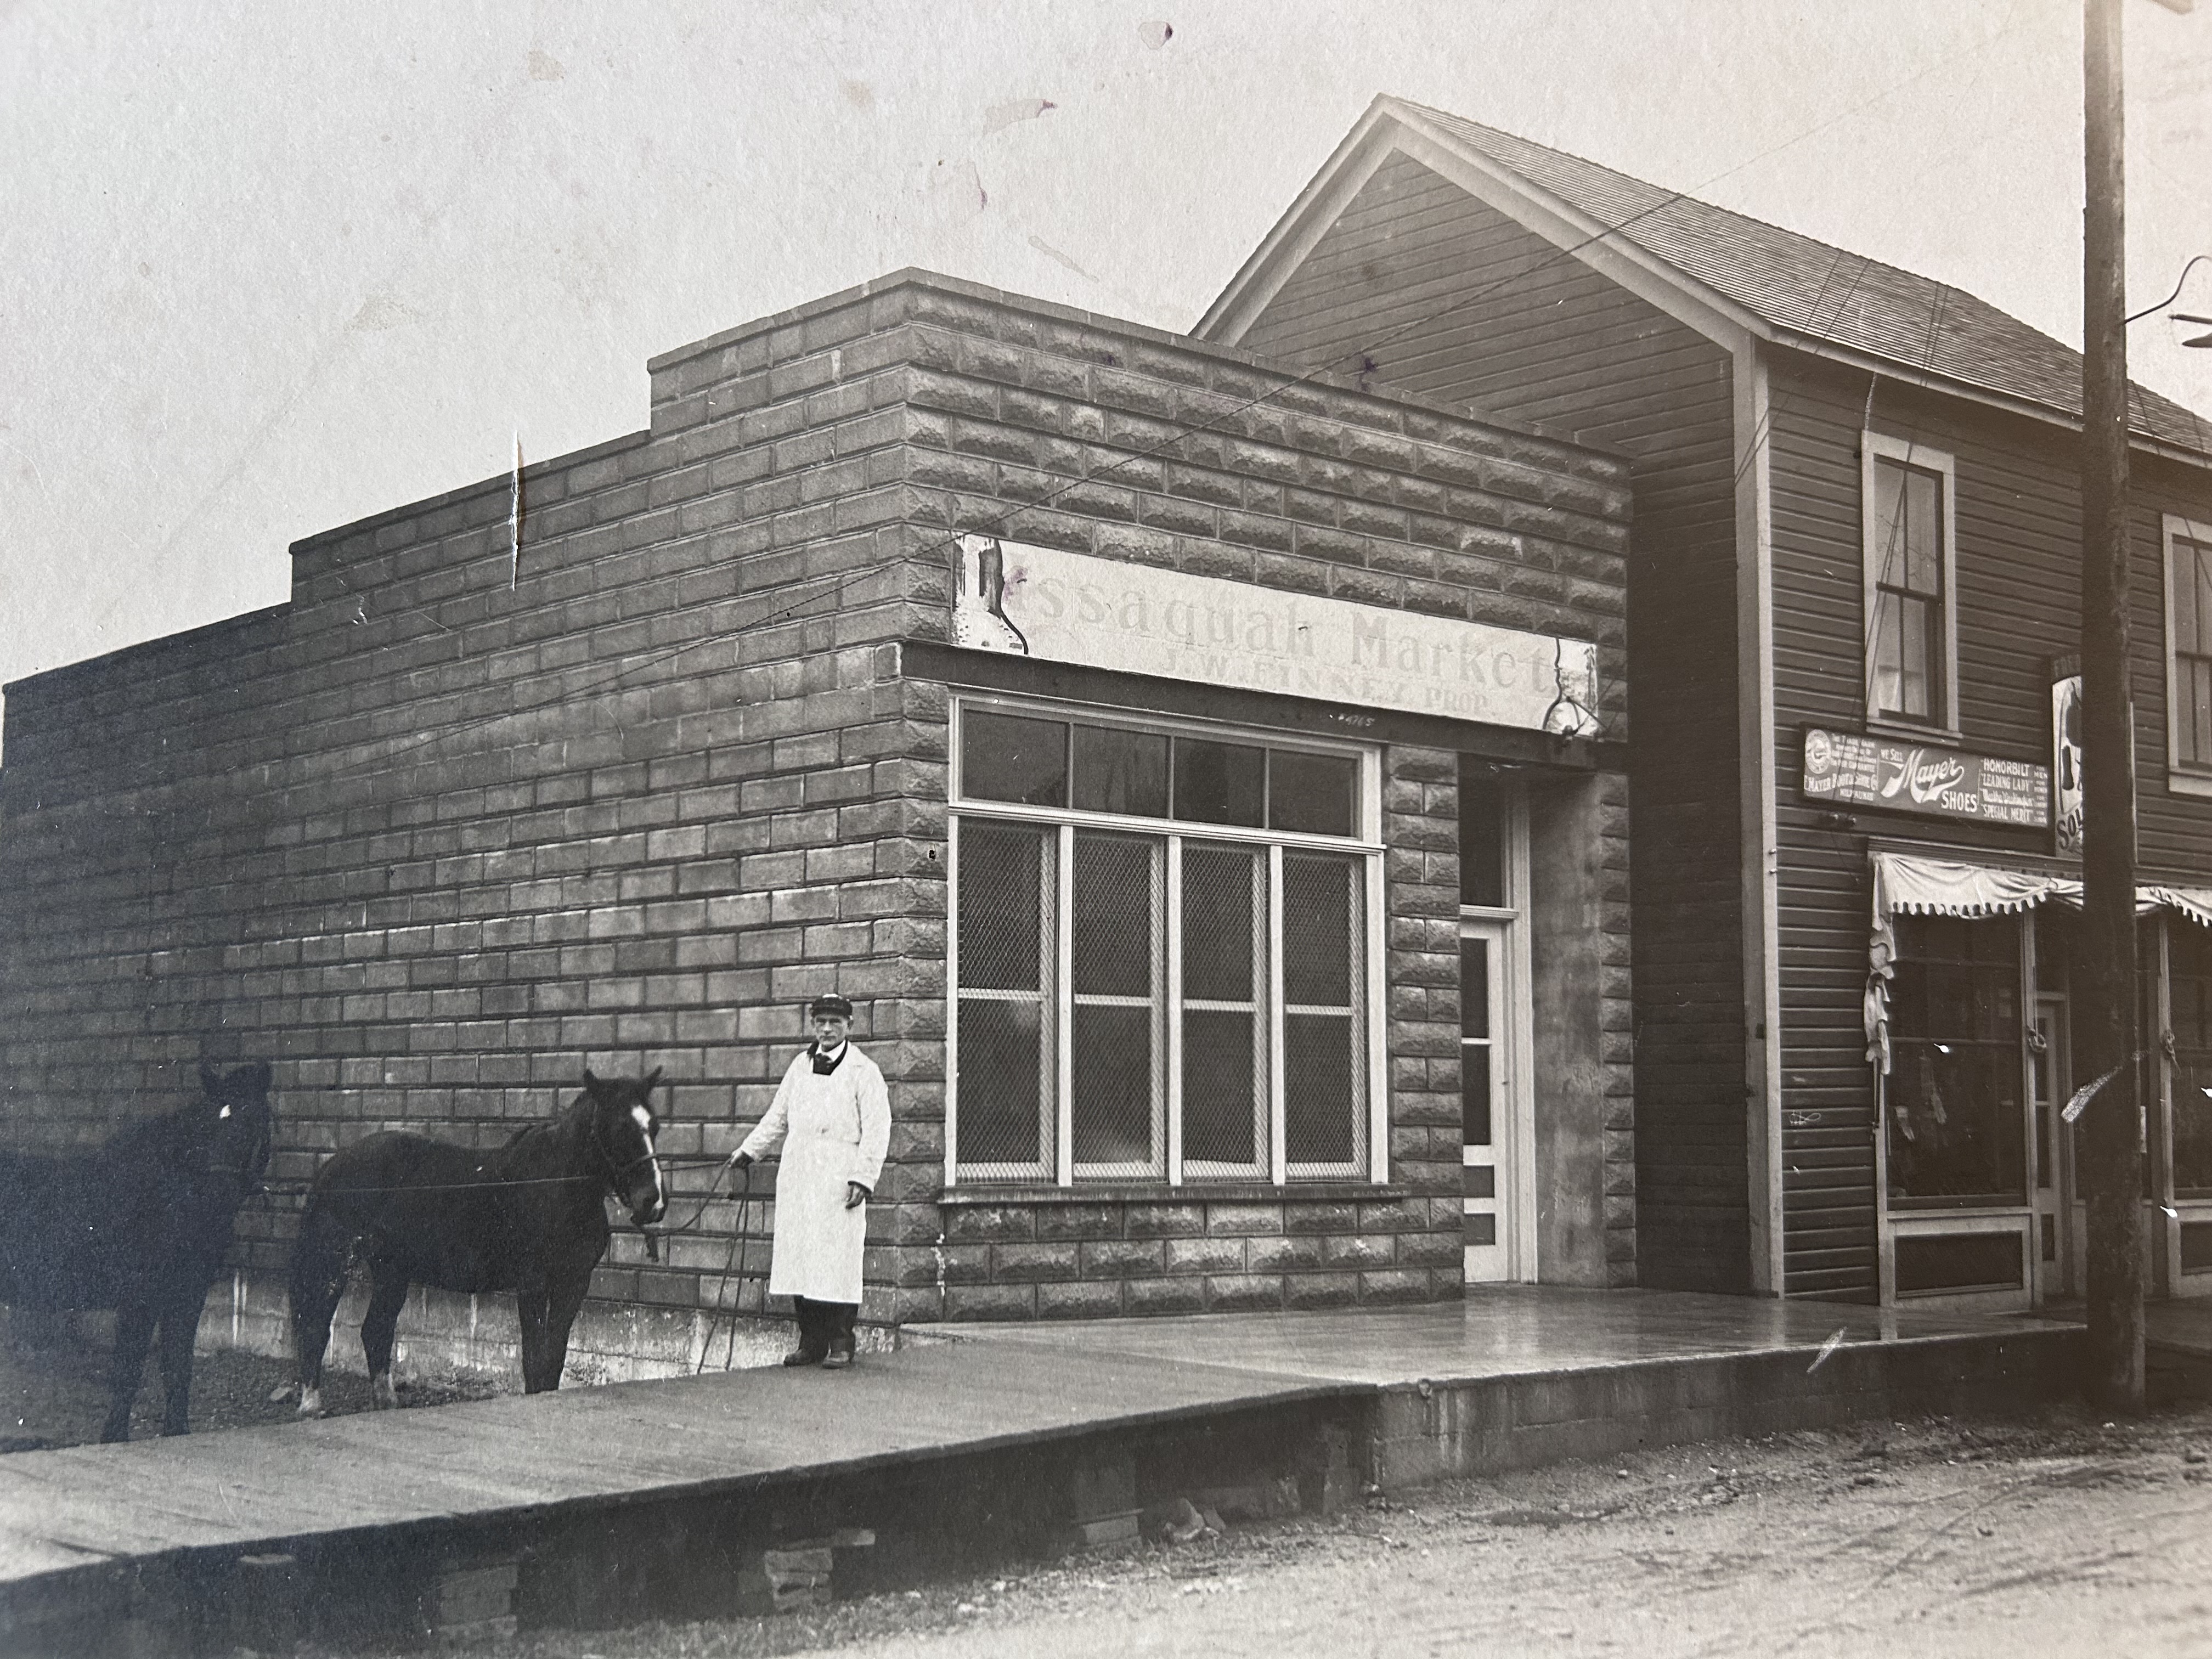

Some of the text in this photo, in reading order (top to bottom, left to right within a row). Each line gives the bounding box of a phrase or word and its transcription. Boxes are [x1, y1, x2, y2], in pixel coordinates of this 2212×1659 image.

[1351, 610, 1549, 693] Market
[1880, 748, 1965, 804] Mayer
[1940, 789, 1978, 812] SHOES
